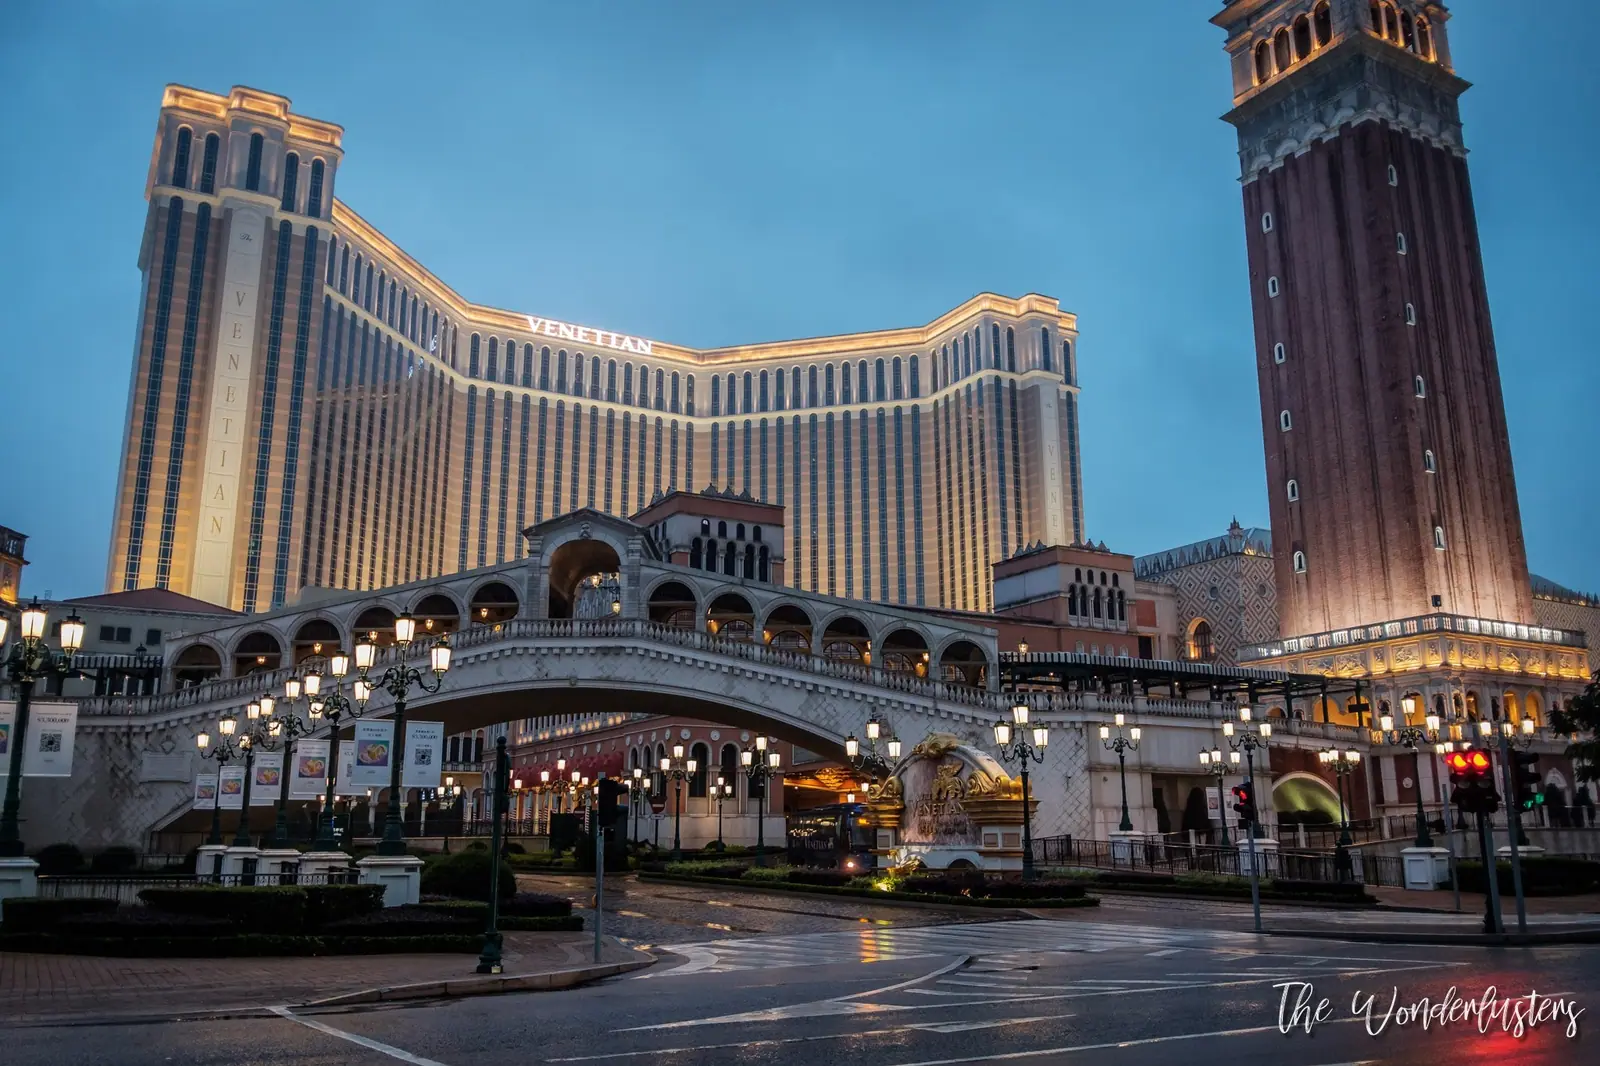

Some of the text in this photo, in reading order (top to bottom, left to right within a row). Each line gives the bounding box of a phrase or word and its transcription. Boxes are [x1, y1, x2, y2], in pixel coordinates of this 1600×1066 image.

[526, 315, 654, 354] VENETIAN
[210, 290, 247, 535] VENETIAN
[911, 801, 966, 816] VENETIAN
